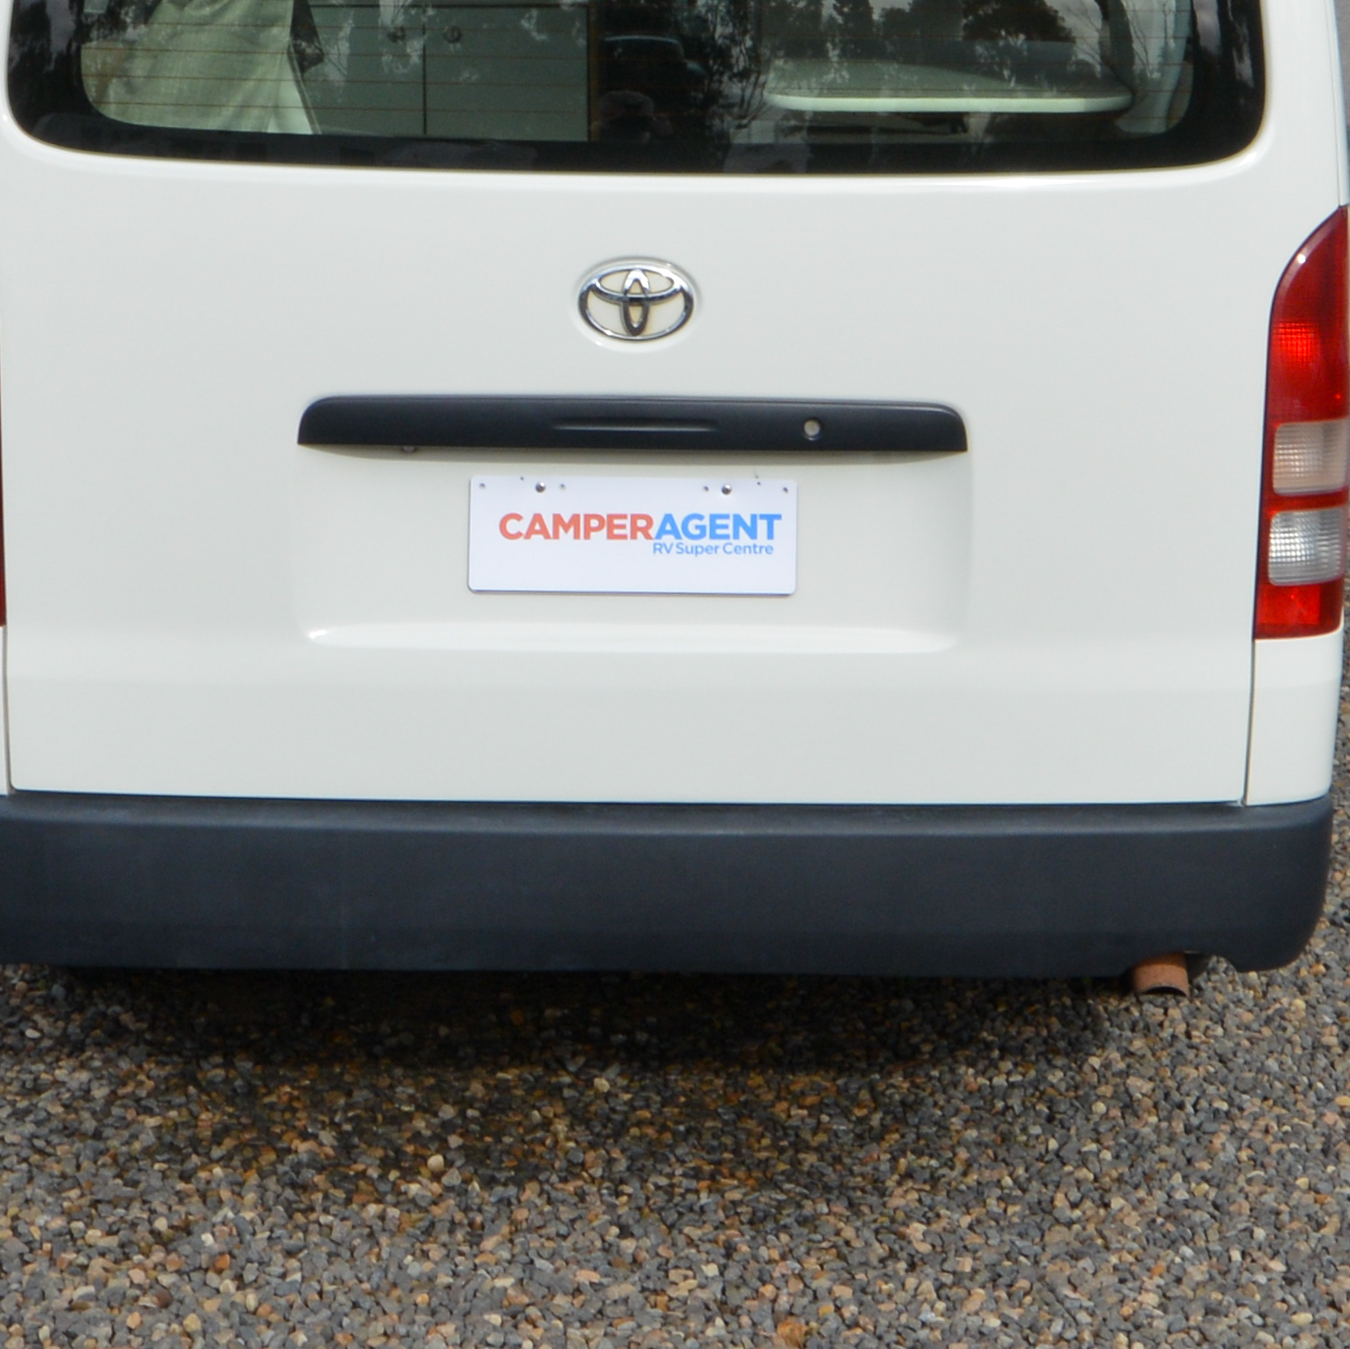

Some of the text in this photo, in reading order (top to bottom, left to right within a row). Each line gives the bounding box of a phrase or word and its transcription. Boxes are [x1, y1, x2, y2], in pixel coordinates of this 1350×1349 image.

[498, 512, 783, 541] CAMPERAGENT
[653, 542, 774, 557] RV Super Centre
